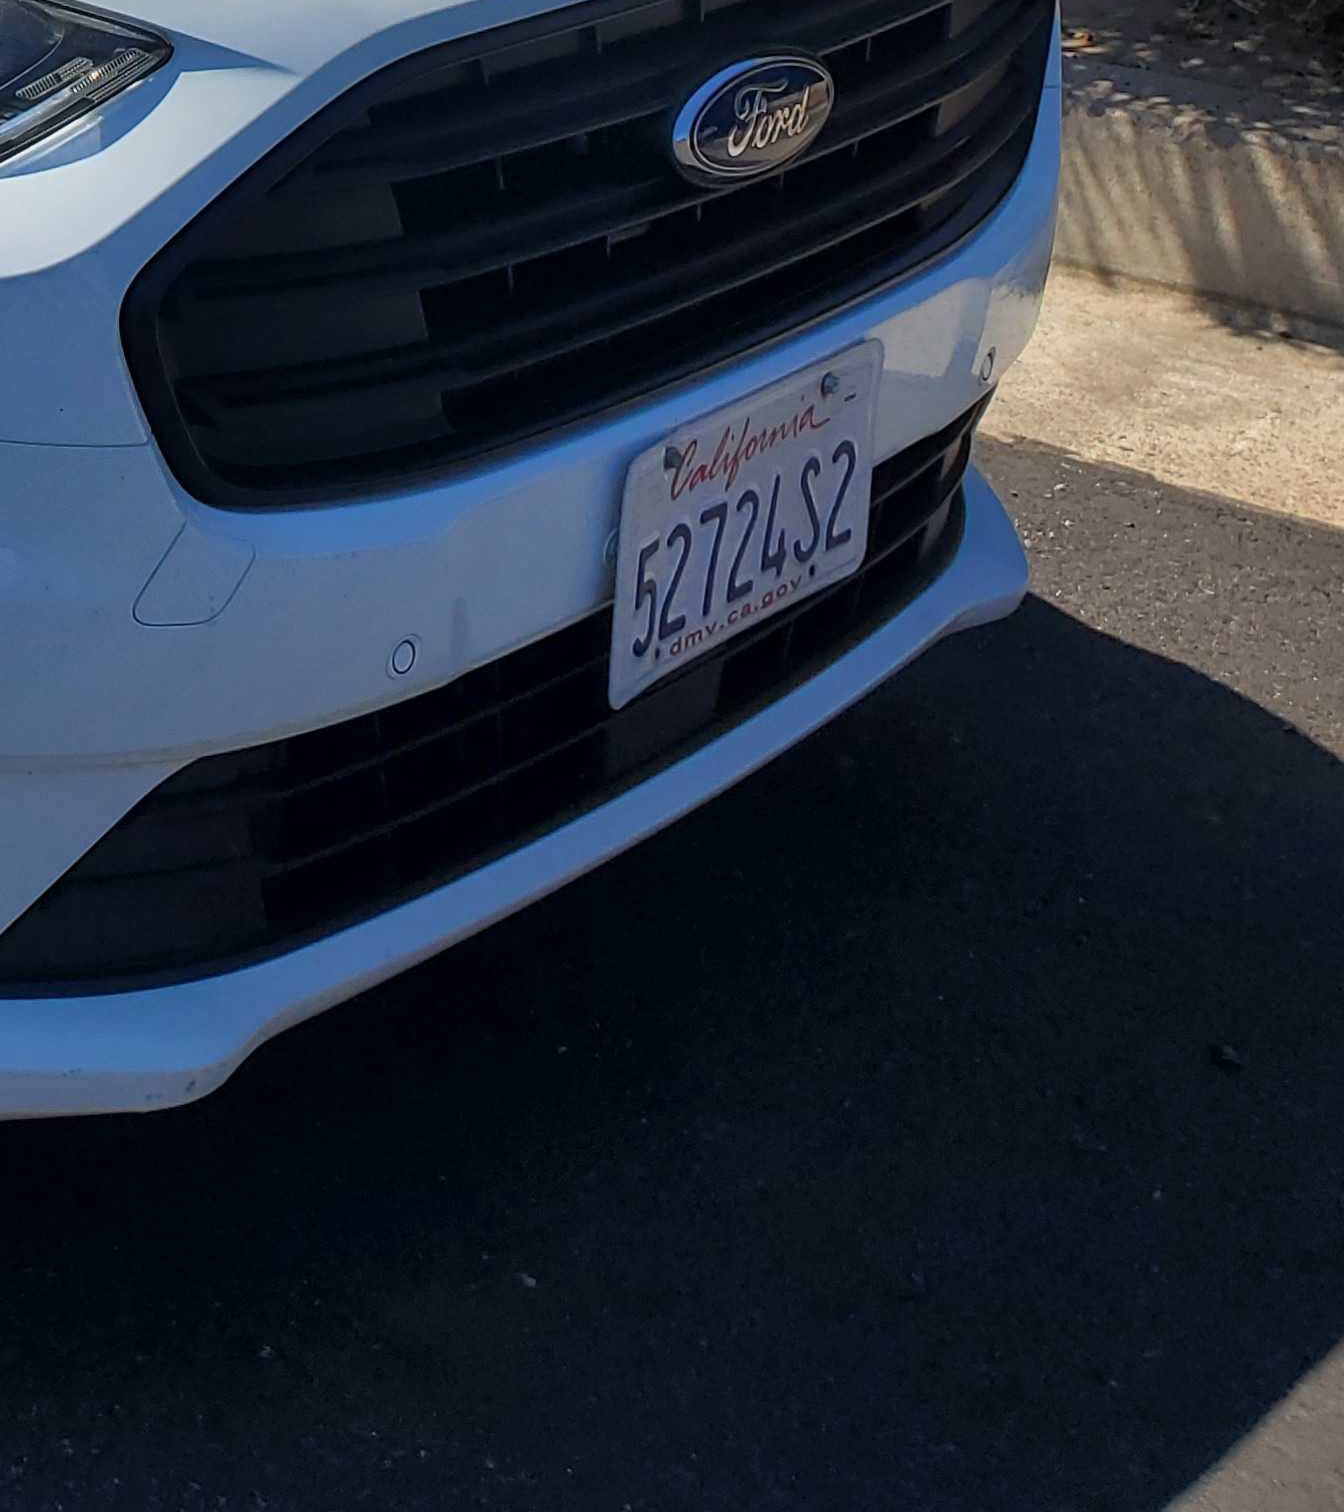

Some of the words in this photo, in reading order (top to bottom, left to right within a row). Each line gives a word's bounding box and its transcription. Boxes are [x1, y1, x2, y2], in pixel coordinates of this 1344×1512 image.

[728, 77, 809, 157] Ford
[669, 395, 831, 501] California
[632, 439, 857, 657] 52724S2
[669, 575, 802, 657] dmv.ca.gov
